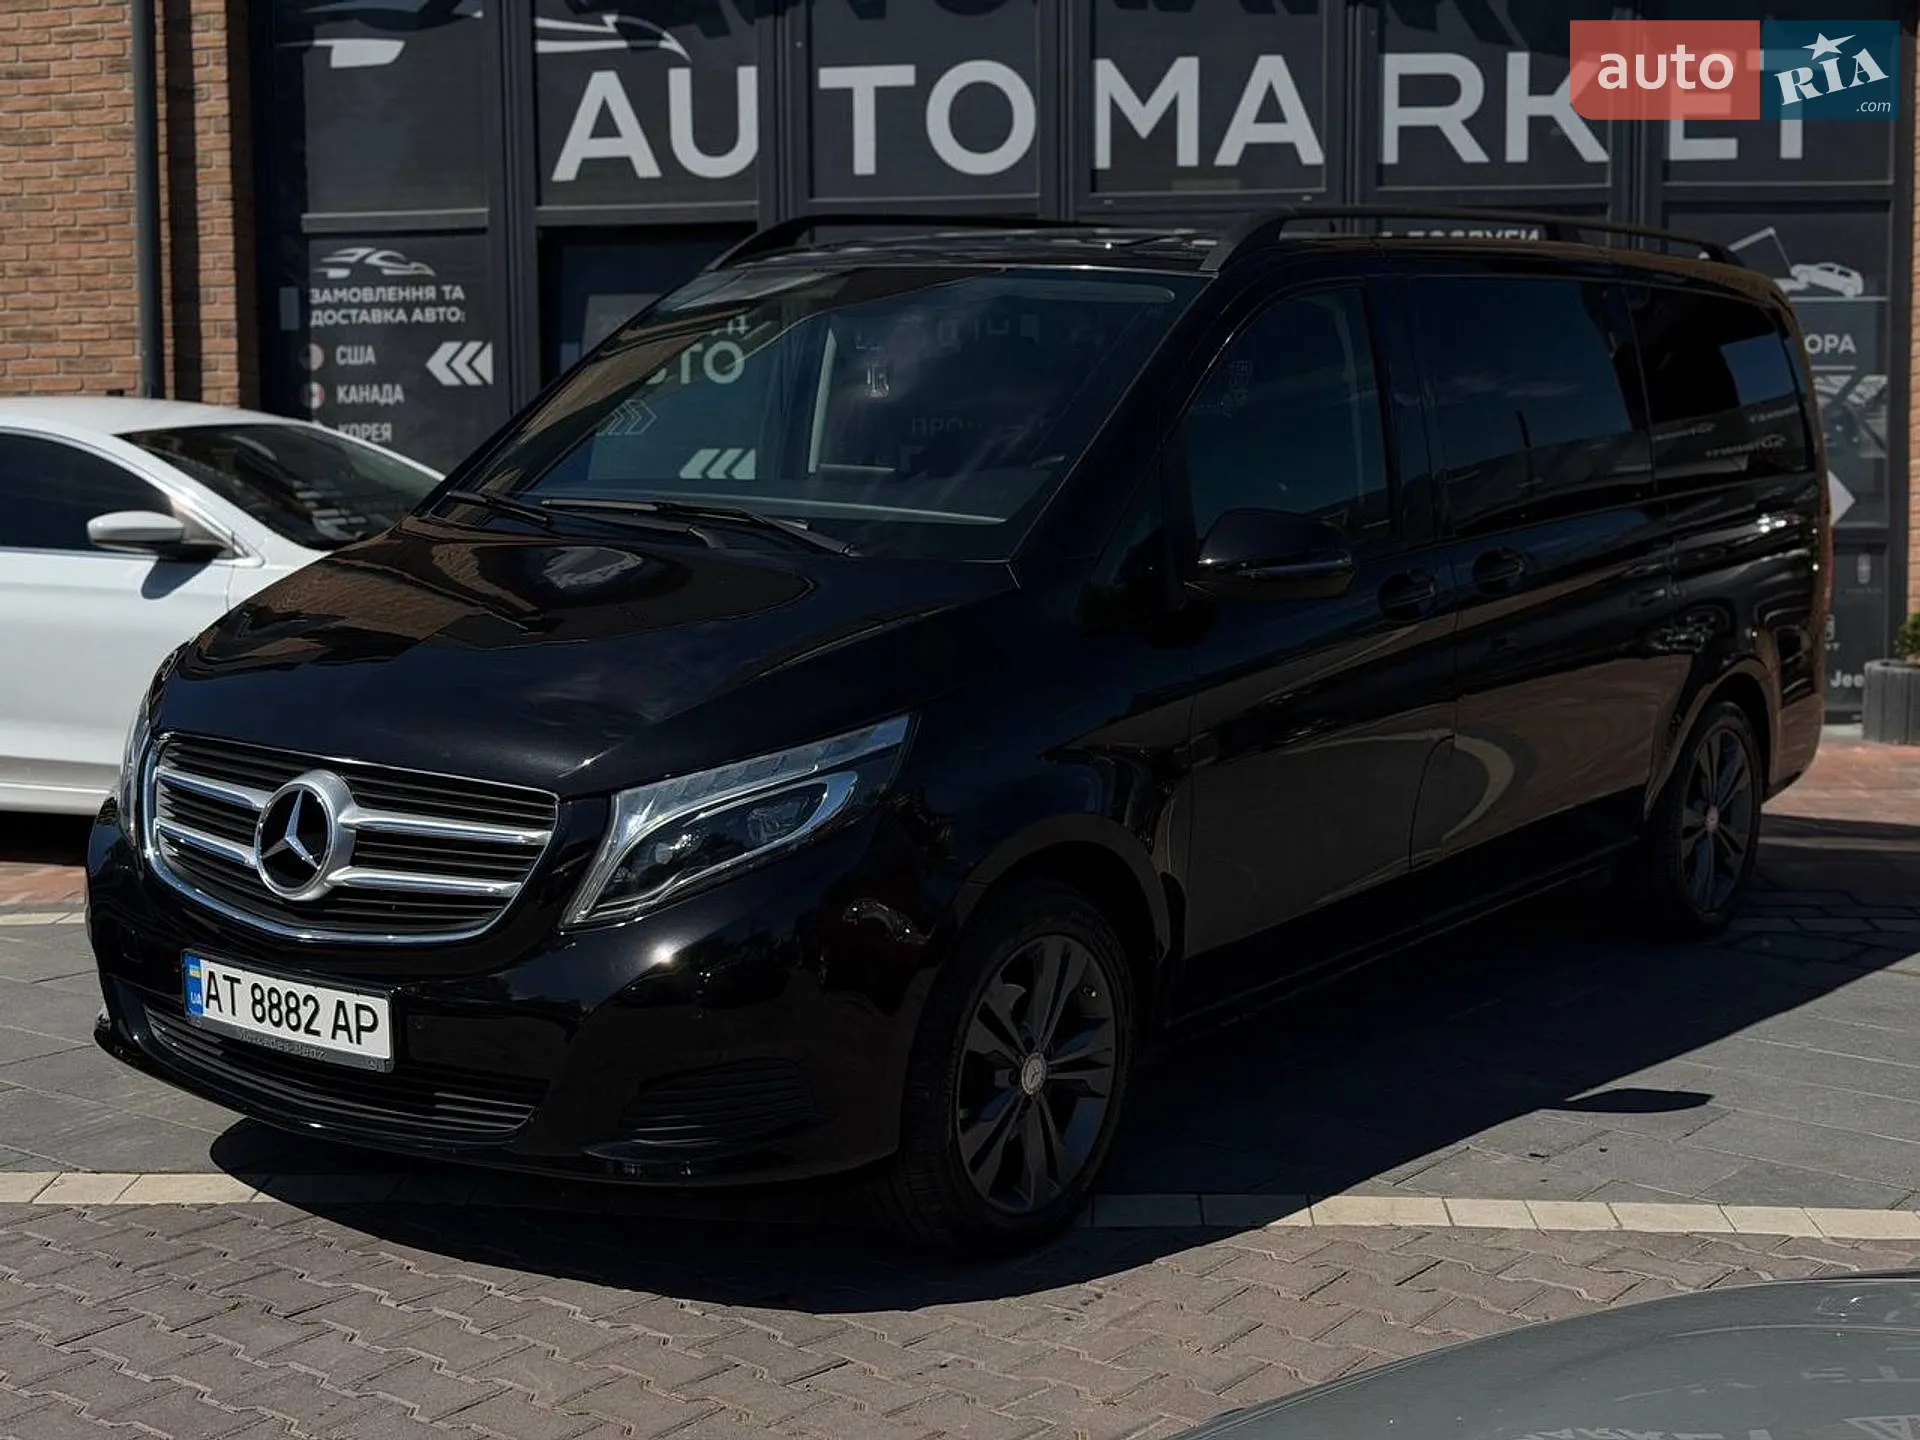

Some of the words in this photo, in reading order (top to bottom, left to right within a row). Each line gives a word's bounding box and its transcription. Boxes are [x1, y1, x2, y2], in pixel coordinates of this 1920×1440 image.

[309, 285, 437, 304] ЗАМОВЛЕННЯ
[441, 284, 465, 300] ТА
[310, 307, 408, 327] ДОСТАВКА
[335, 345, 376, 366] США
[336, 383, 405, 405] КАНАДА
[1829, 669, 1865, 688] Jee
[205, 969, 242, 1017] AT
[250, 982, 321, 1037] 8882
[331, 999, 378, 1045] AP
